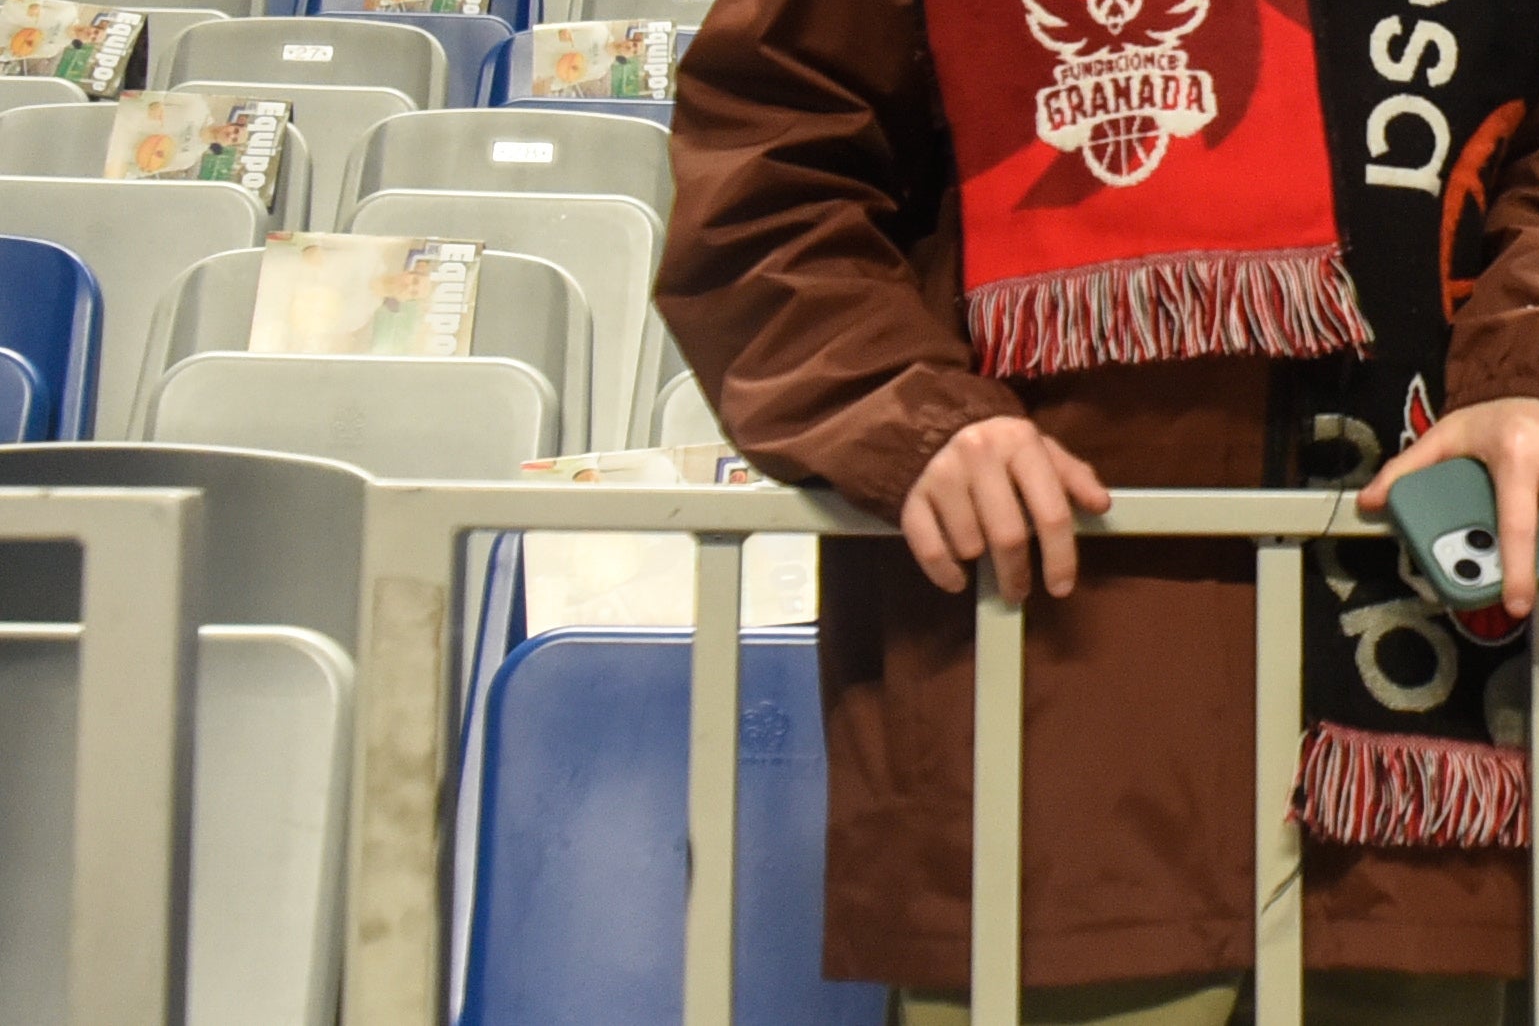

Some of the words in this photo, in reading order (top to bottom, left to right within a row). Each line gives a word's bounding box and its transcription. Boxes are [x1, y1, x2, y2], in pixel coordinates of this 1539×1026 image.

[92, 11, 143, 81] Equipo
[644, 21, 672, 90] Equipo
[1044, 73, 1206, 131] GRANADA
[241, 101, 287, 190] Equipo
[423, 244, 475, 355] Equipo
